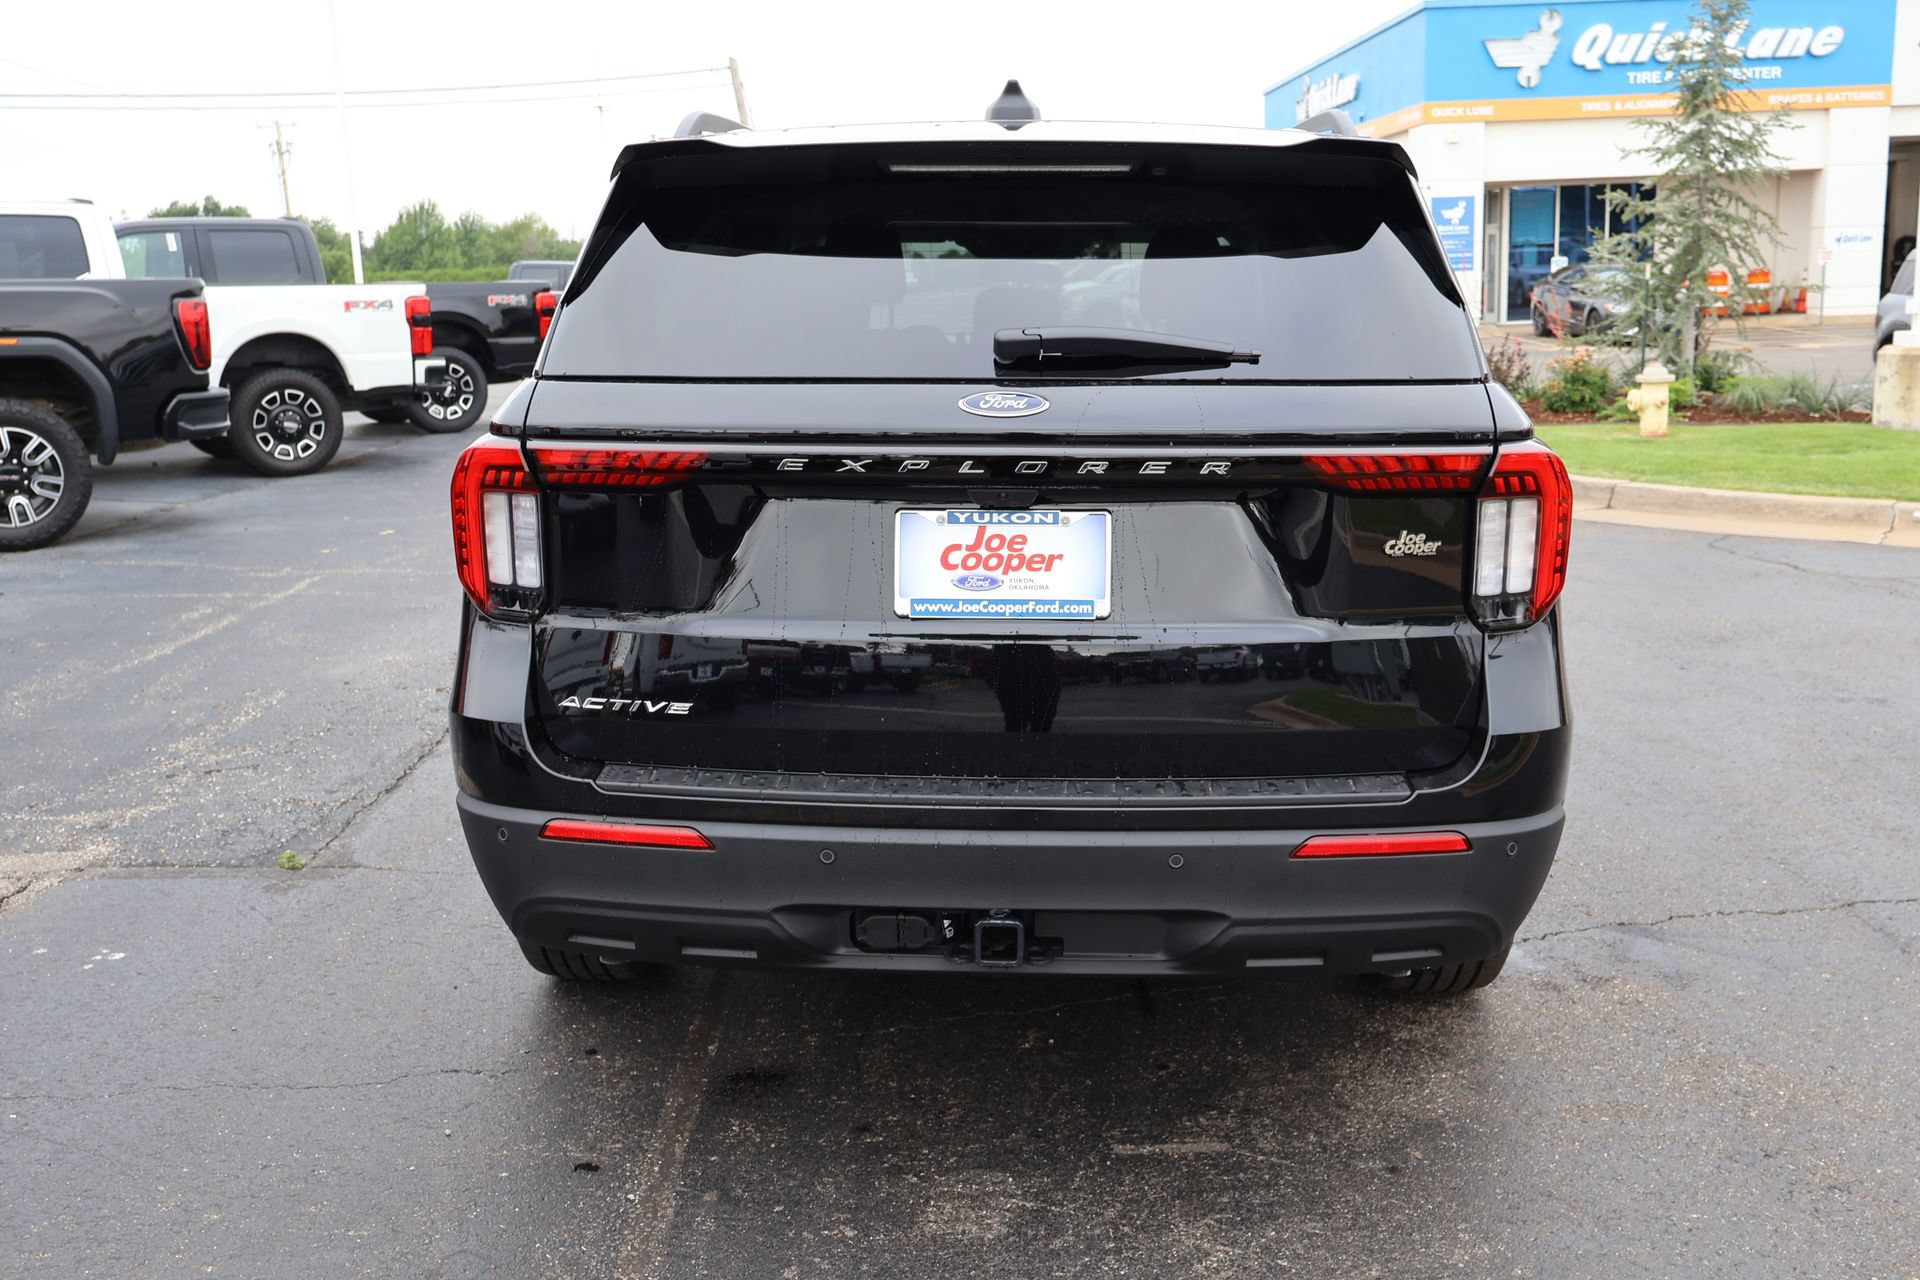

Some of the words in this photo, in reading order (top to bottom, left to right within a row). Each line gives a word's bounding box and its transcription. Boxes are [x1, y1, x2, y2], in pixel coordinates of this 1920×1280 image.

[1572, 22, 1715, 70] Quick
[1721, 19, 1845, 59] Lane
[1627, 70, 1662, 84] TIRE
[1825, 90, 1885, 102] BATTERIES
[1431, 107, 1464, 117] QUICK
[1467, 105, 1495, 116] LUBE
[344, 299, 393, 313] FX4
[980, 394, 1028, 409] Ford
[777, 457, 1232, 476] EXPLORER
[953, 512, 1055, 524] YUKON
[965, 525, 1028, 553] Joe
[1396, 530, 1427, 545] Joe
[1384, 540, 1442, 555] Cooper
[940, 543, 1064, 575] Cooper
[964, 575, 991, 587] Ford
[913, 600, 1092, 615] www.JoeCooperFord.com
[558, 696, 694, 715] ACTIVE
